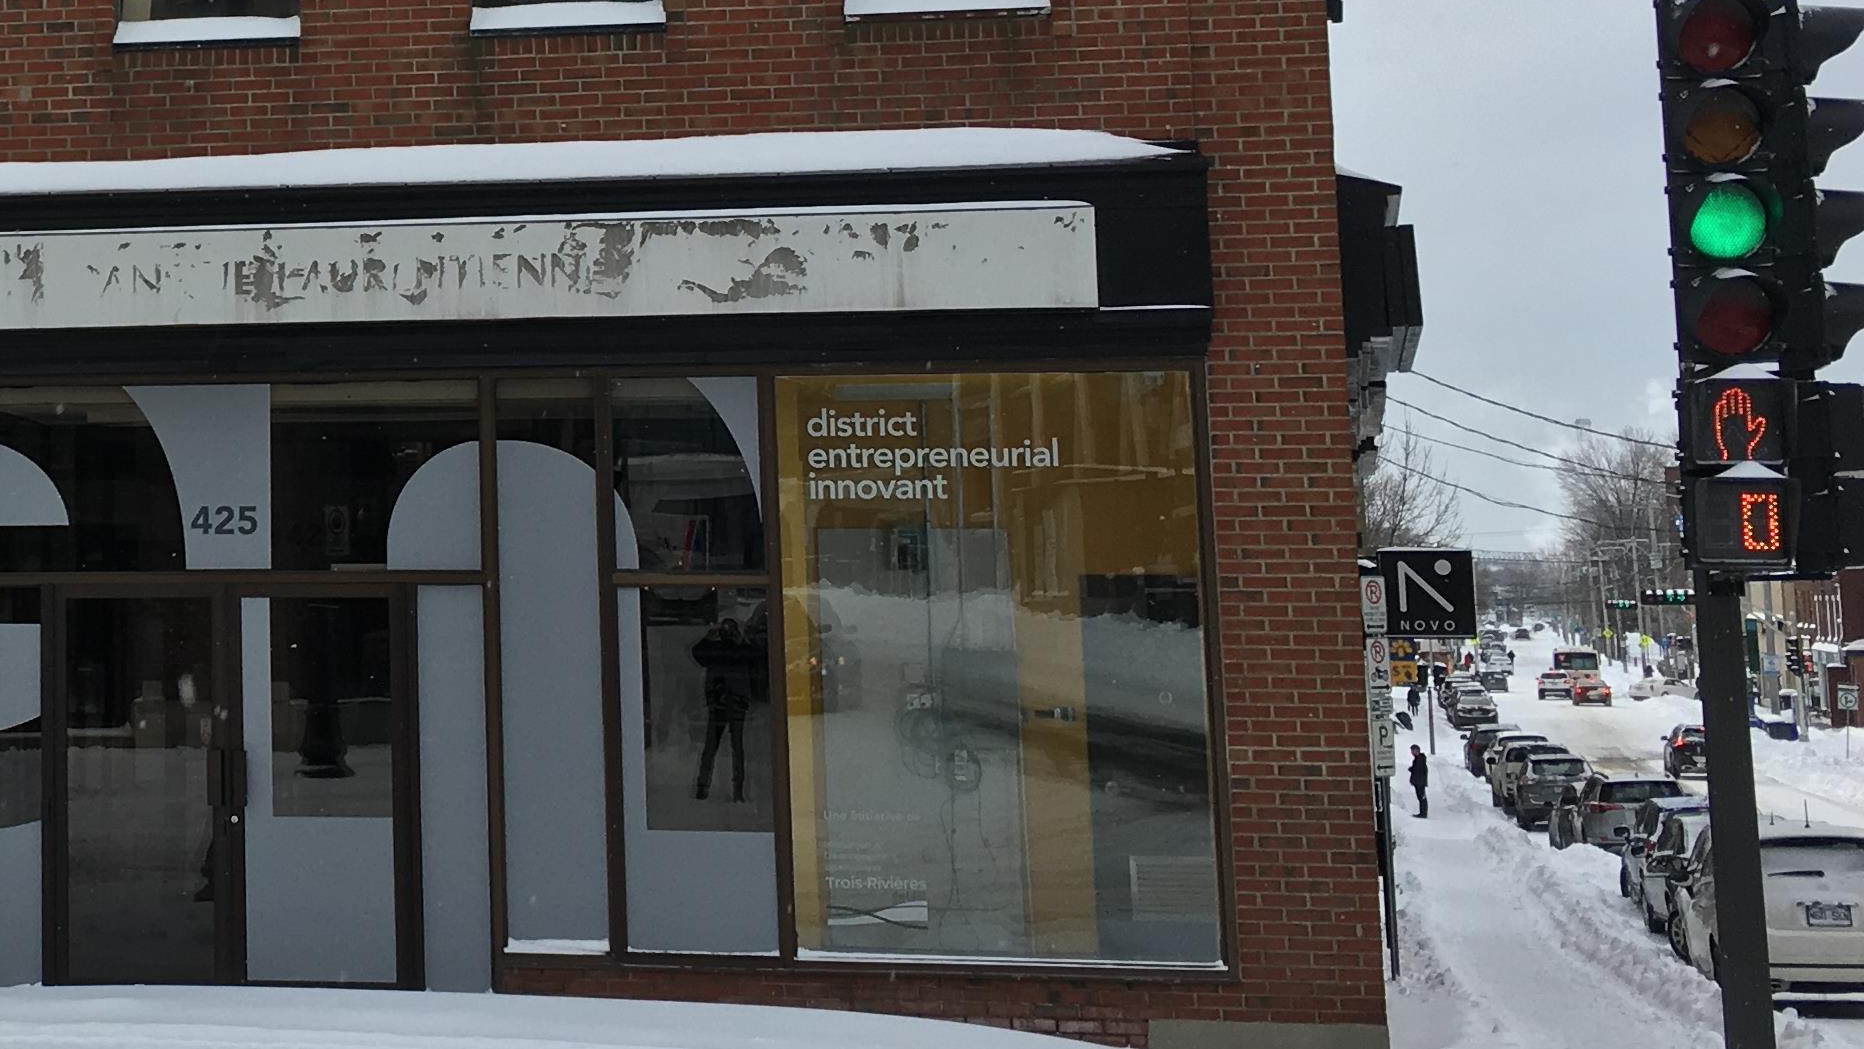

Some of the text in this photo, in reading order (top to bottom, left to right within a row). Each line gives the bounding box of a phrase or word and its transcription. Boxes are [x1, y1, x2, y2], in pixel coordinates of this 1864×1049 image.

[807, 407, 918, 437] district
[808, 437, 1060, 476] entrepreneurial
[808, 472, 949, 500] innovant
[190, 505, 258, 535] 425
[1400, 620, 1456, 631] NOVO
